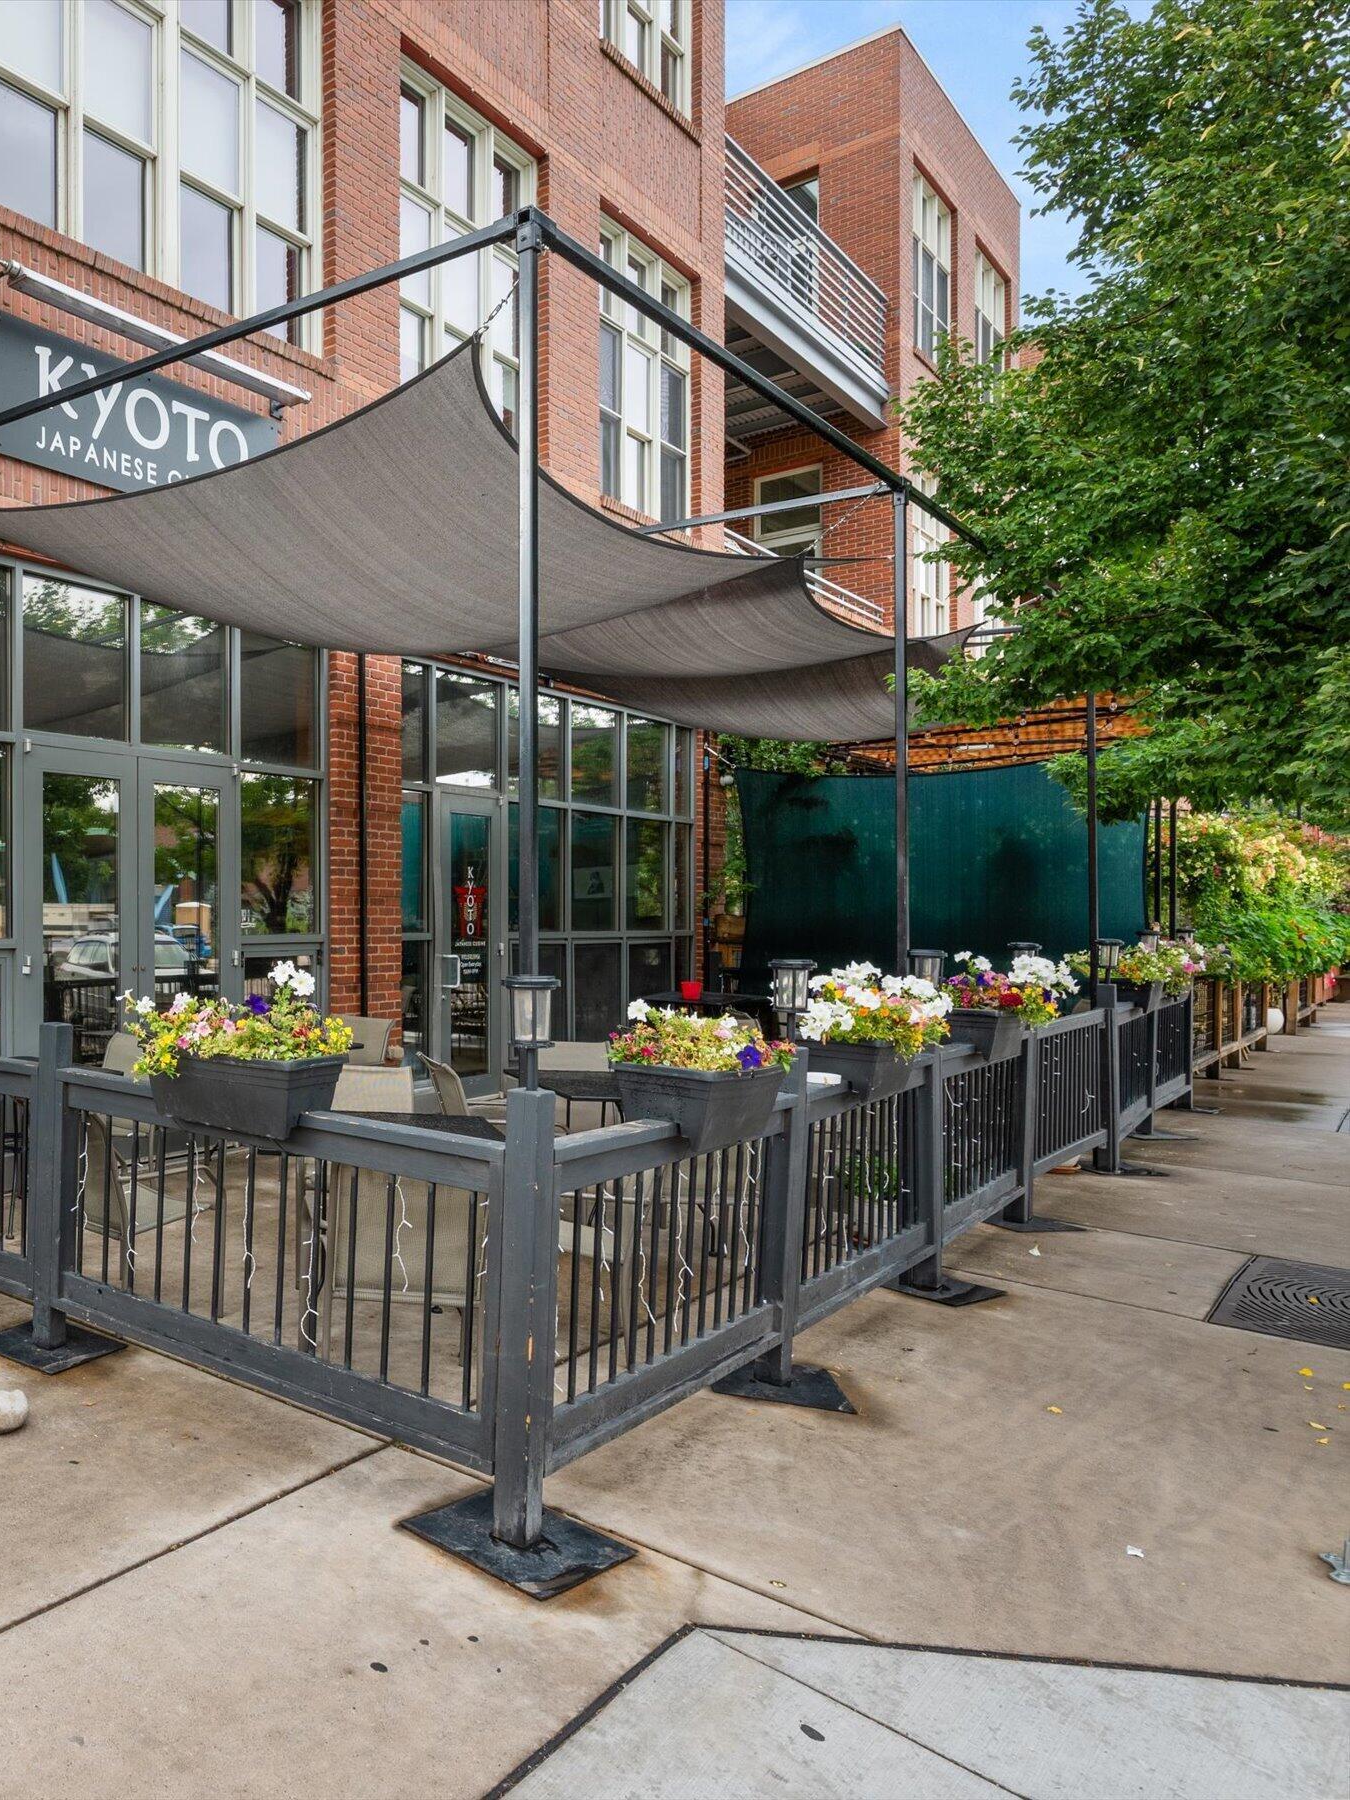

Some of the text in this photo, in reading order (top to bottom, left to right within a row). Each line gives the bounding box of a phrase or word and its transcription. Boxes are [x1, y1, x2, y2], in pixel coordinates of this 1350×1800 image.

[35, 345, 249, 470] KYOTO
[36, 426, 158, 486] JAPANESE
[466, 866, 474, 935] KYOTO
